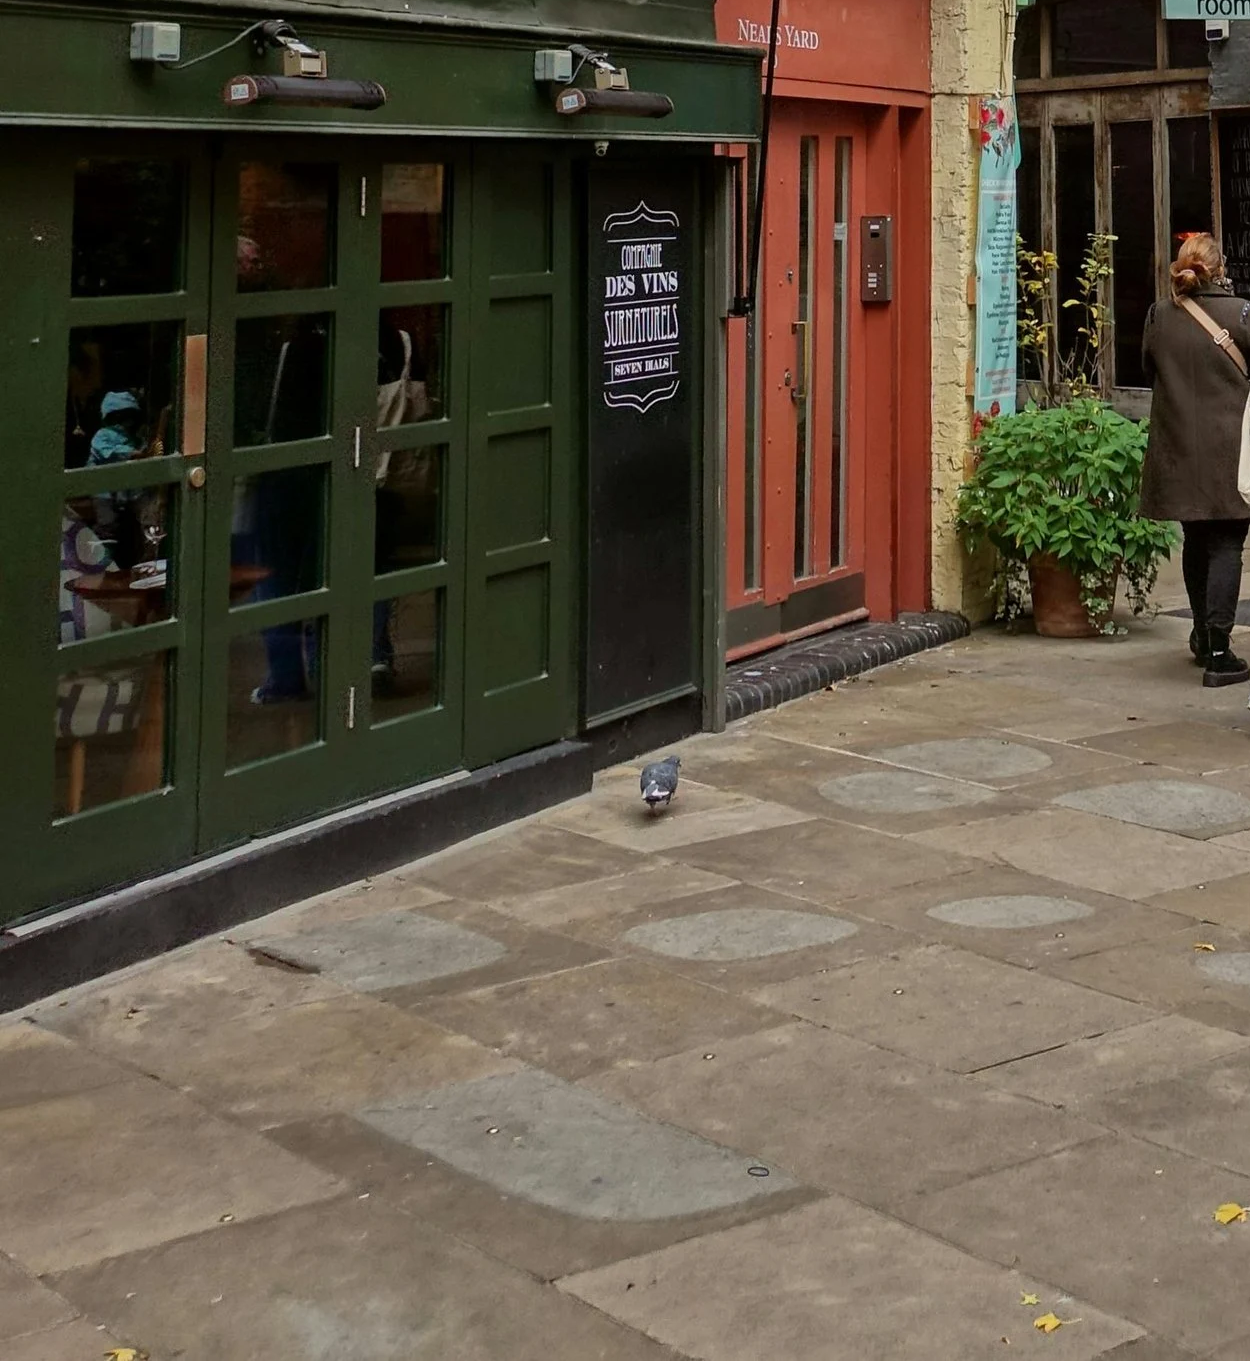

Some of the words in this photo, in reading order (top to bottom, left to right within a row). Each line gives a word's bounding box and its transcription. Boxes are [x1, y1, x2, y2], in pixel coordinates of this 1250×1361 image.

[784, 24, 819, 50] YARD
[621, 243, 663, 271] COMPAGNIE
[605, 273, 636, 298] DES
[641, 271, 678, 295] VINS
[604, 303, 679, 348] SURNATURELS
[614, 360, 642, 376] SEVEN
[645, 356, 670, 372] DIALS
